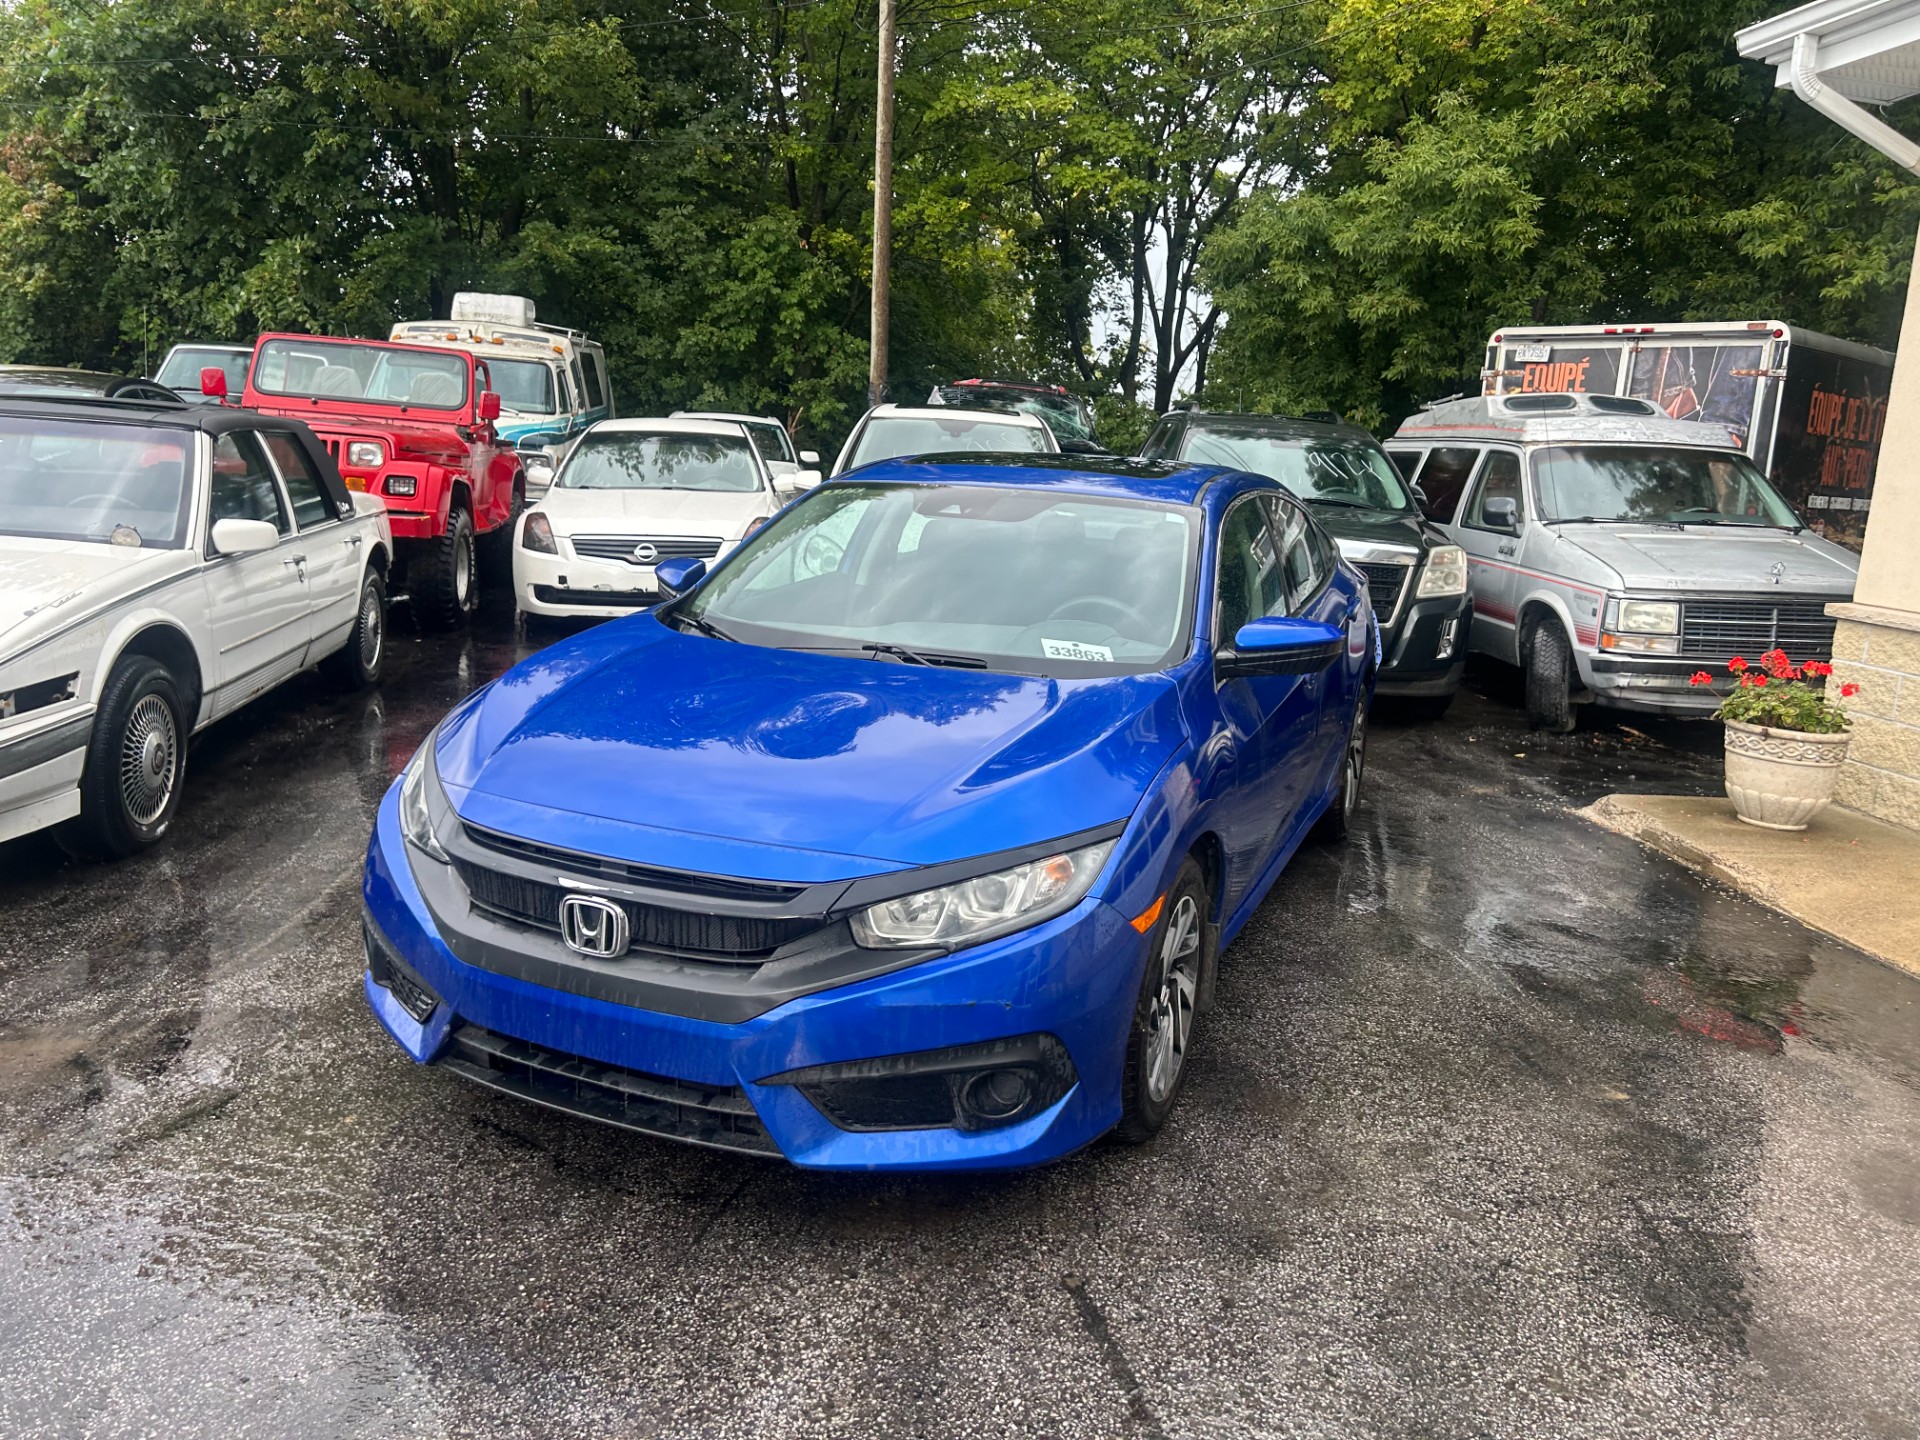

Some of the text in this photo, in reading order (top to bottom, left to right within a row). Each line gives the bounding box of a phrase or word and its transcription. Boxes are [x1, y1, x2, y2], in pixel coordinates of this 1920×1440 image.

[1807, 383, 1846, 437] ÉQUIPÉ
[1843, 398, 1861, 440] DE
[1049, 646, 1107, 661] 33863
